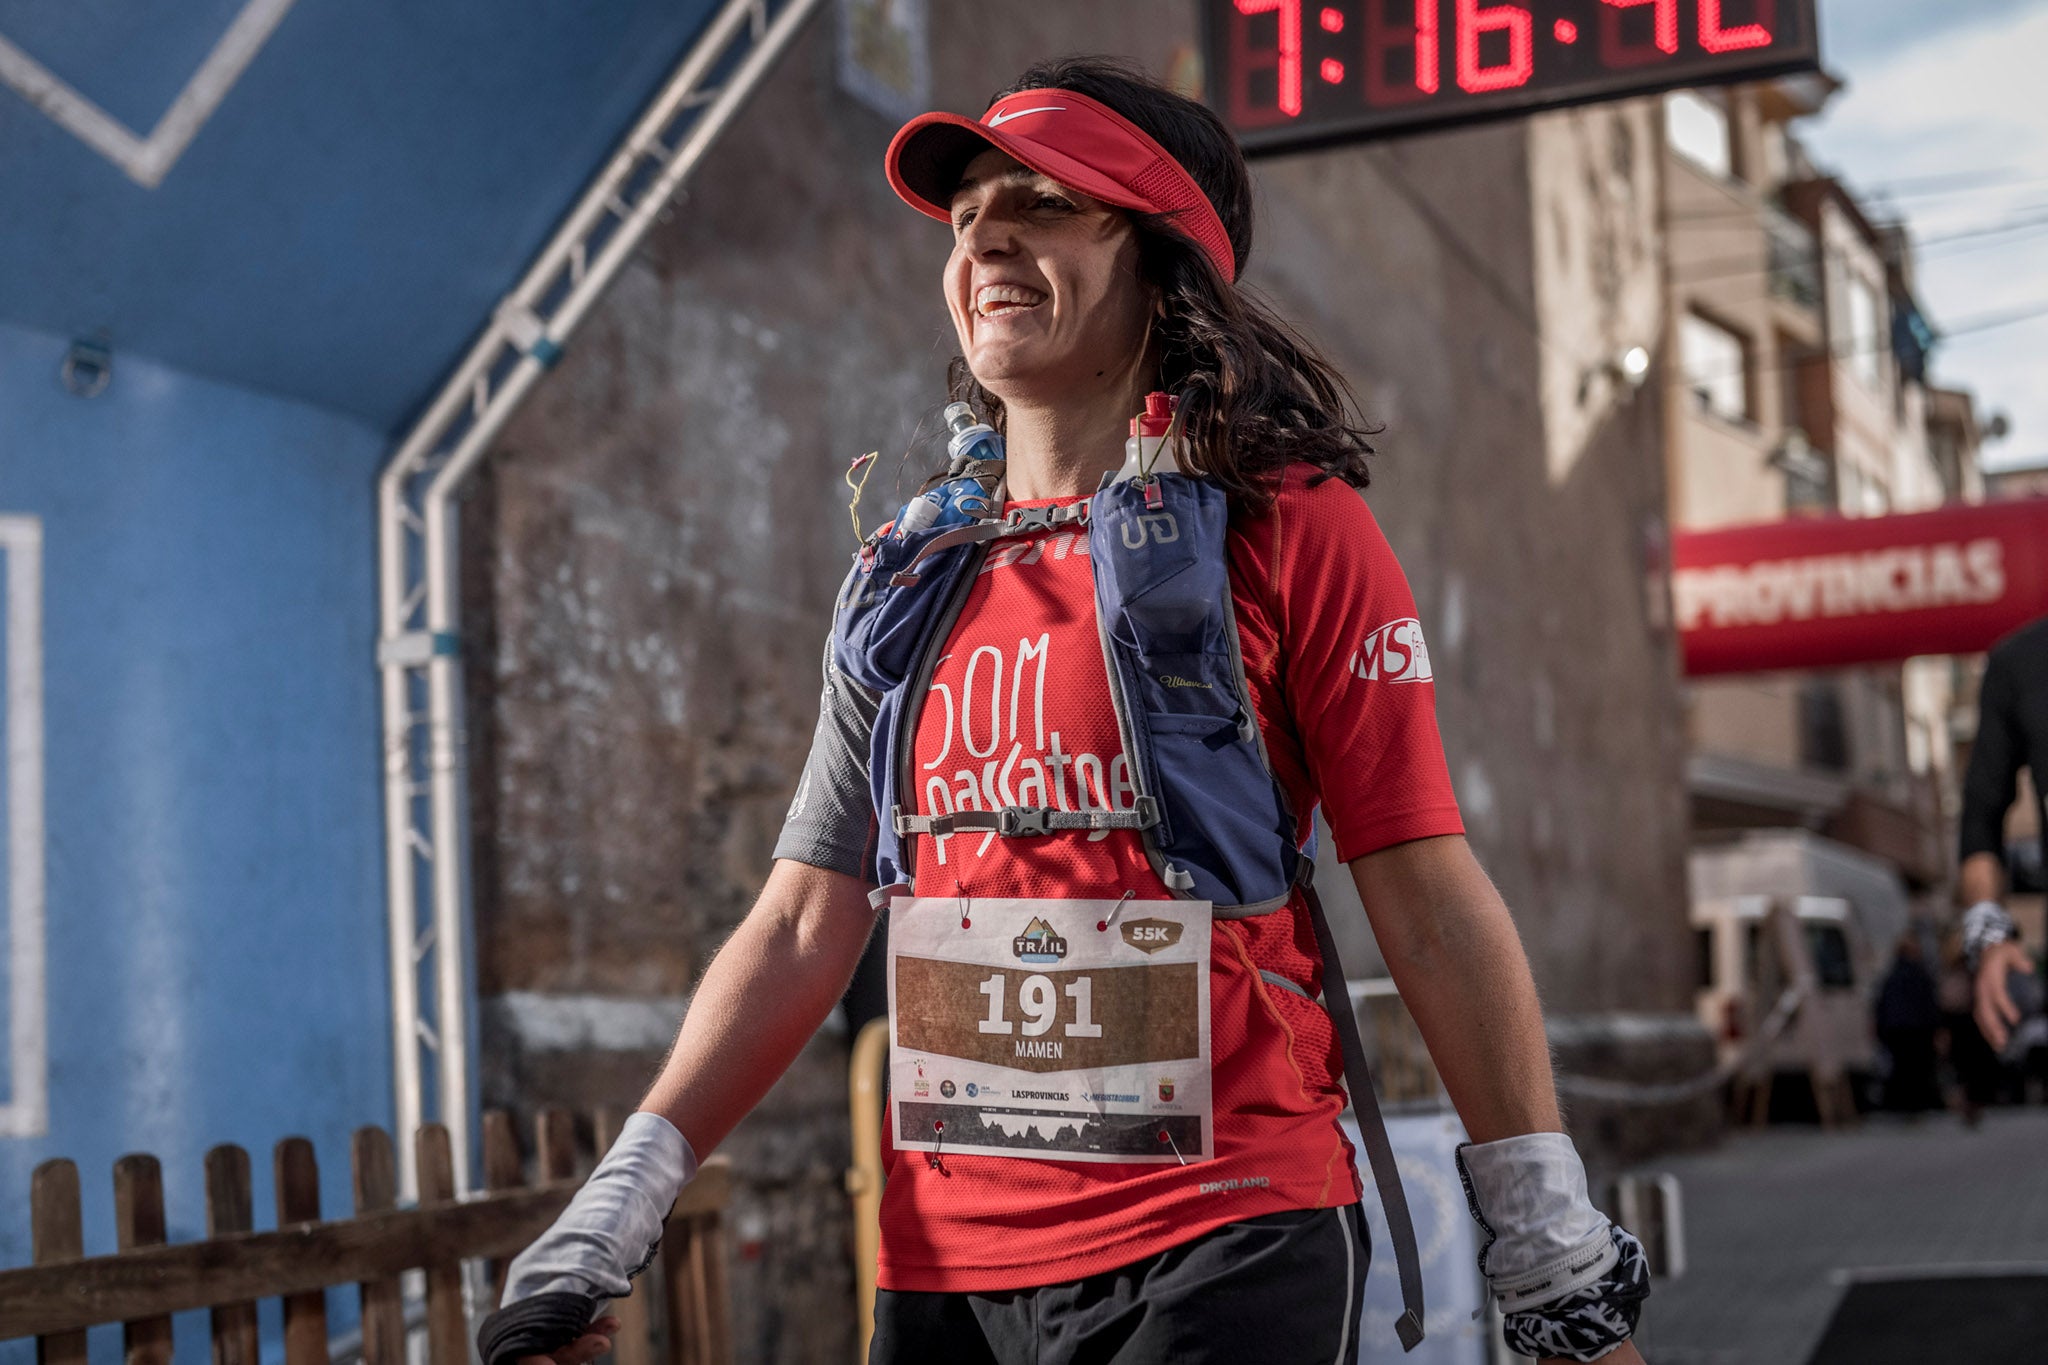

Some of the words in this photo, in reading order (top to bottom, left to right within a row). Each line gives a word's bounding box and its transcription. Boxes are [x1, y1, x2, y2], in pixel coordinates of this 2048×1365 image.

[1132, 927, 1169, 941] 55K
[978, 974, 1103, 1038] 191
[1015, 1040, 1062, 1060] MAMEN
